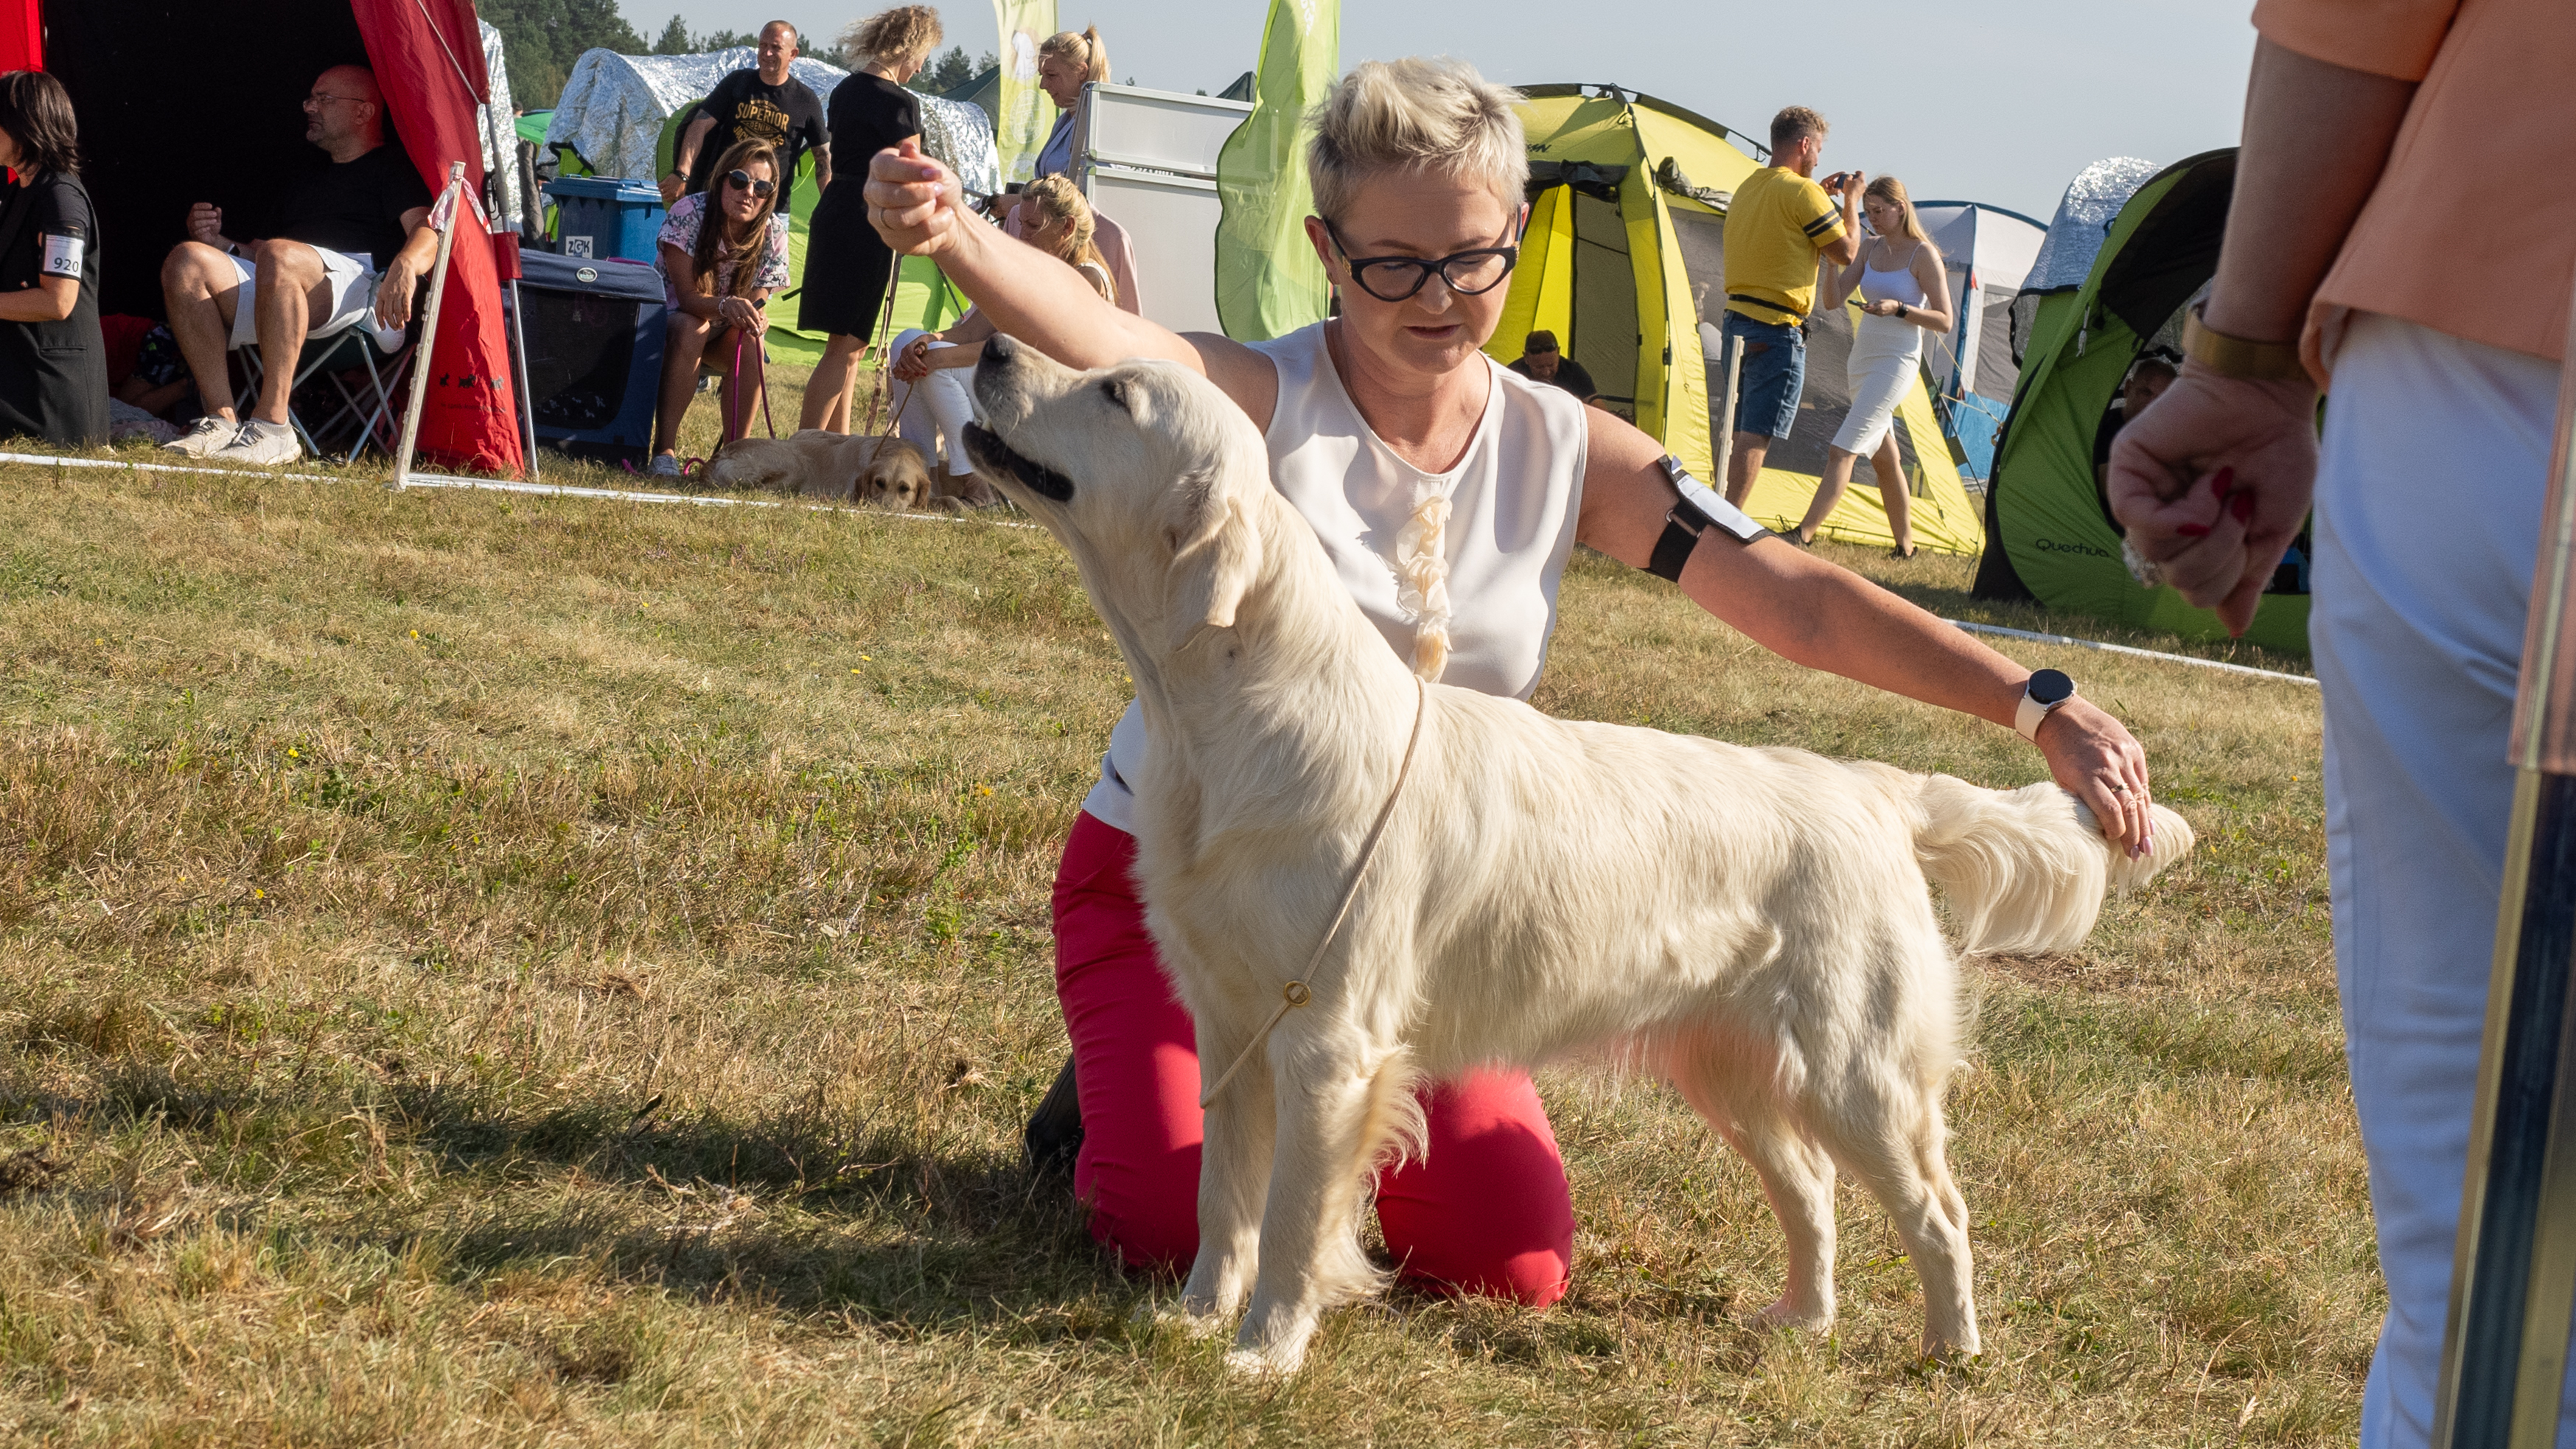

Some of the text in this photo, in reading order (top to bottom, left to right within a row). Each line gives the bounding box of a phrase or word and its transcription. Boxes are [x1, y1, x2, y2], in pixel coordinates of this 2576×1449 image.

[735, 102, 789, 132] SUPERIOR
[750, 122, 771, 132] DENIM
[568, 240, 590, 254] ZGK
[54, 257, 79, 273] 920
[2036, 538, 2110, 558] Quechua
